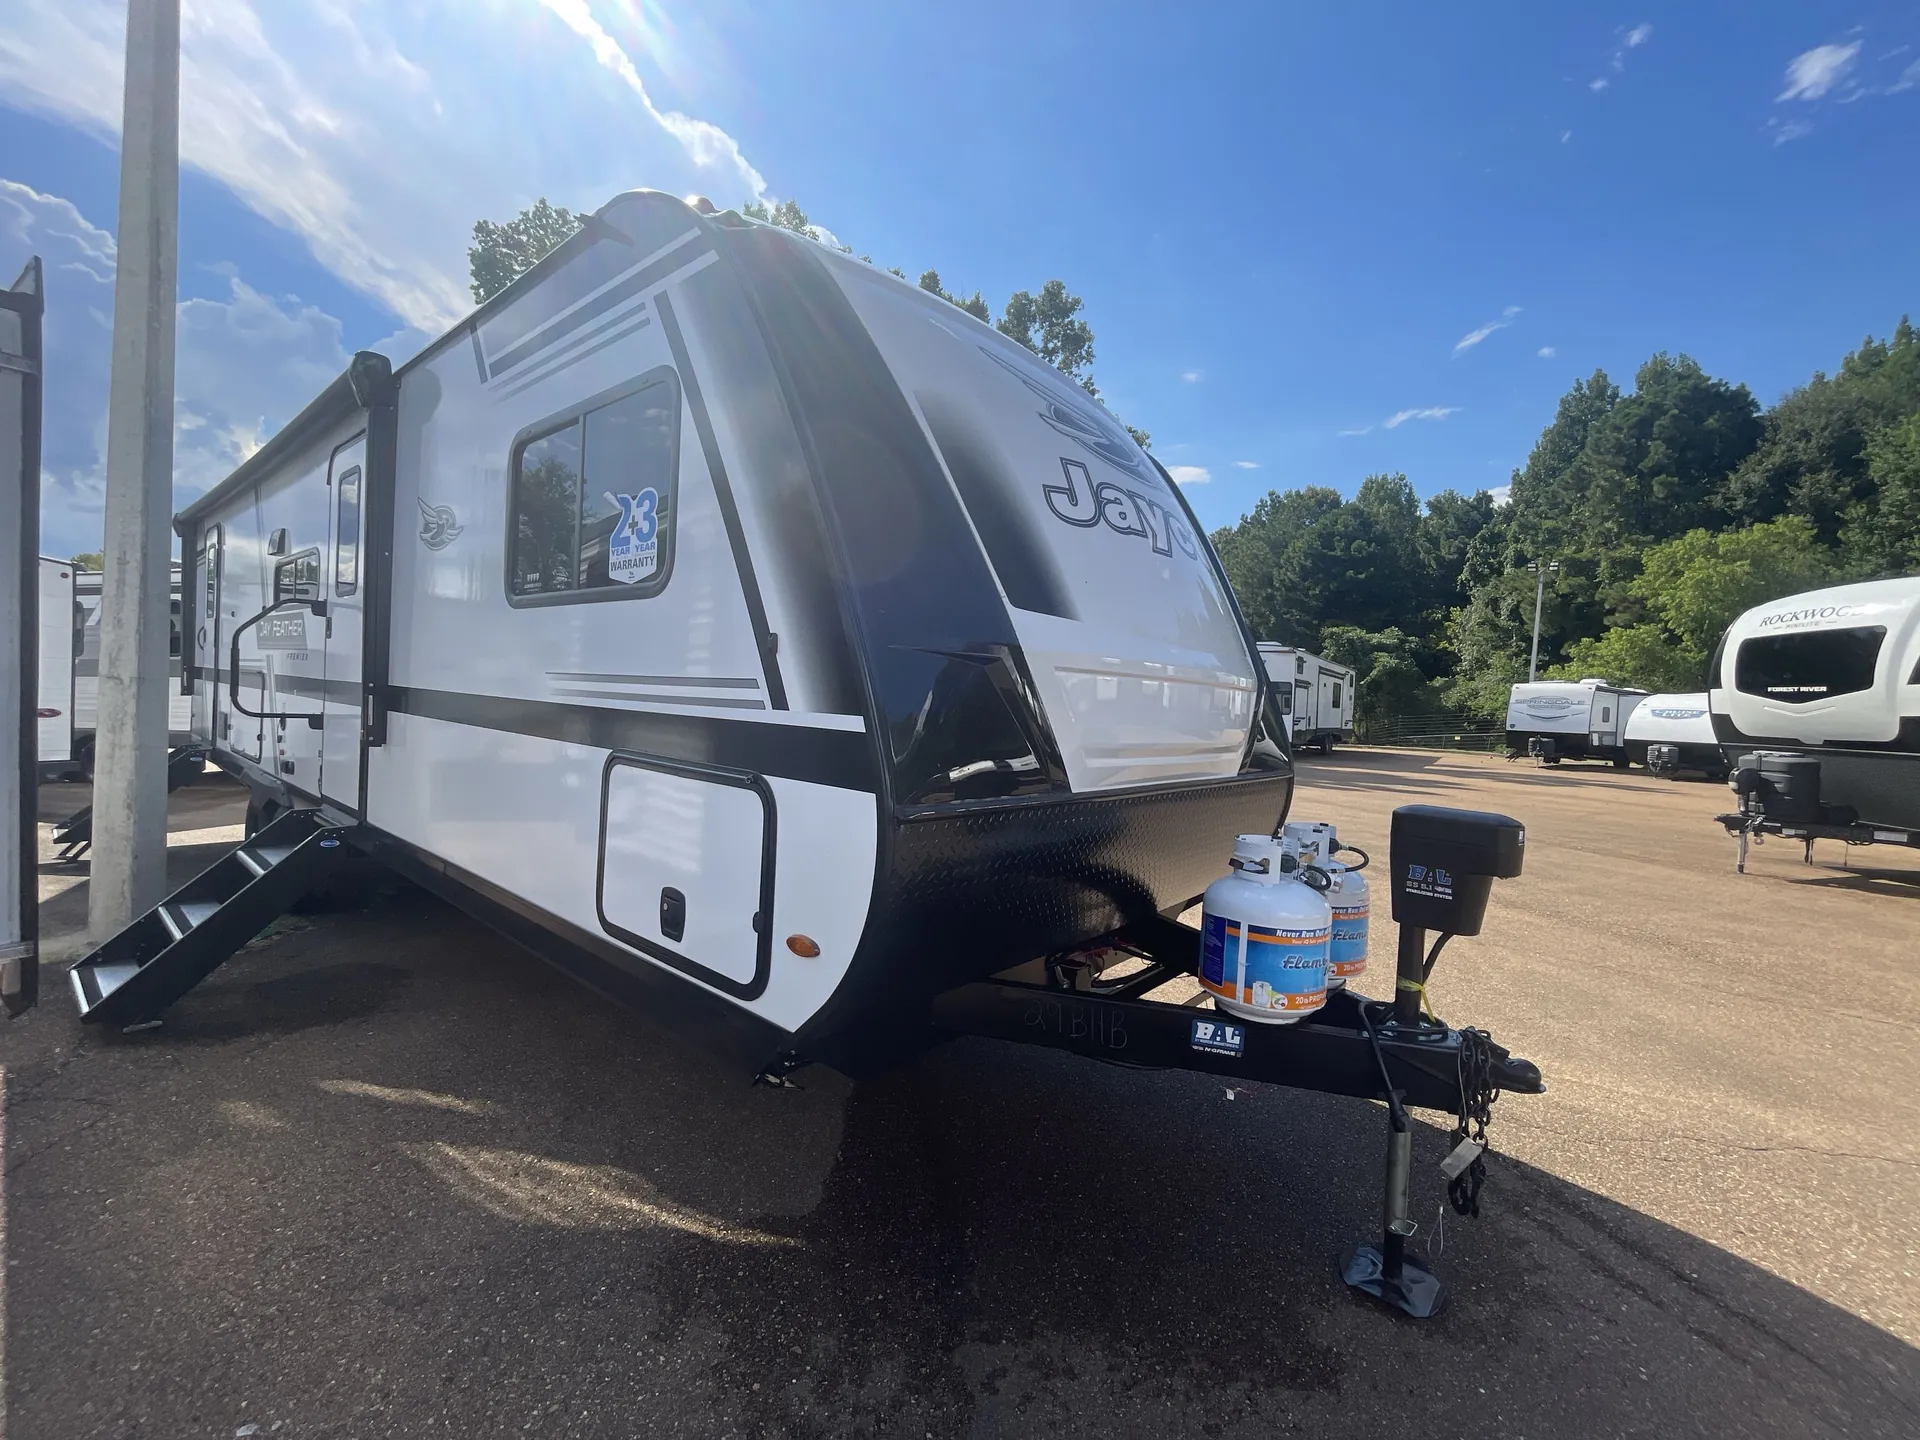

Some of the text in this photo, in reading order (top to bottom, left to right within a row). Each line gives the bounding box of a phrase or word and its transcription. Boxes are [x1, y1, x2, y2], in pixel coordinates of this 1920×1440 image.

[1042, 456, 1202, 561] Jayc
[611, 546, 630, 557] YEAR
[634, 541, 656, 553] YEAR
[610, 555, 656, 572] WARRANTY
[272, 619, 303, 637] FEATHER
[1514, 698, 1586, 706] SPRINGDALE
[1276, 929, 1300, 938] Never
[1301, 930, 1314, 938] Run
[1315, 929, 1324, 937] Out
[1196, 1022, 1240, 1044] BAL
